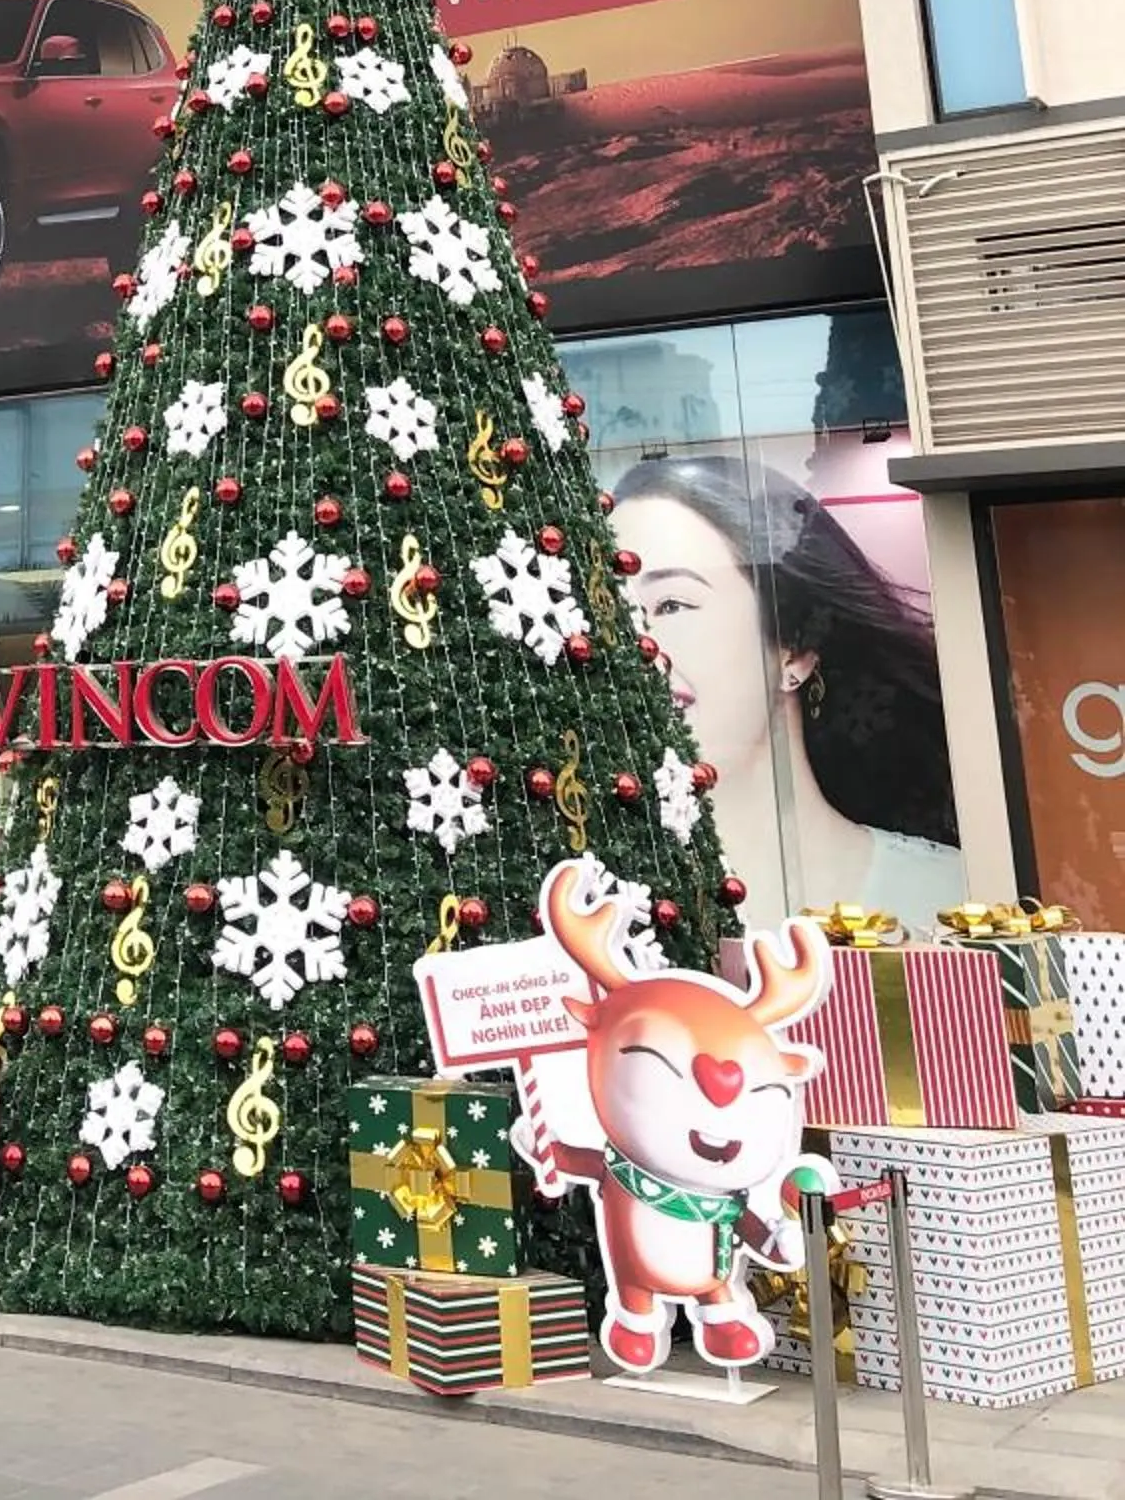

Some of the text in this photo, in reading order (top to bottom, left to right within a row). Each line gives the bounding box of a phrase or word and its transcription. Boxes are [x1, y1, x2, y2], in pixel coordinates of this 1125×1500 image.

[451, 980, 510, 1001] CHECK-IN
[513, 972, 548, 992] SỐNG
[520, 995, 551, 1016] ĐẸP
[470, 1013, 570, 1044] NGHÌN LIKE!
